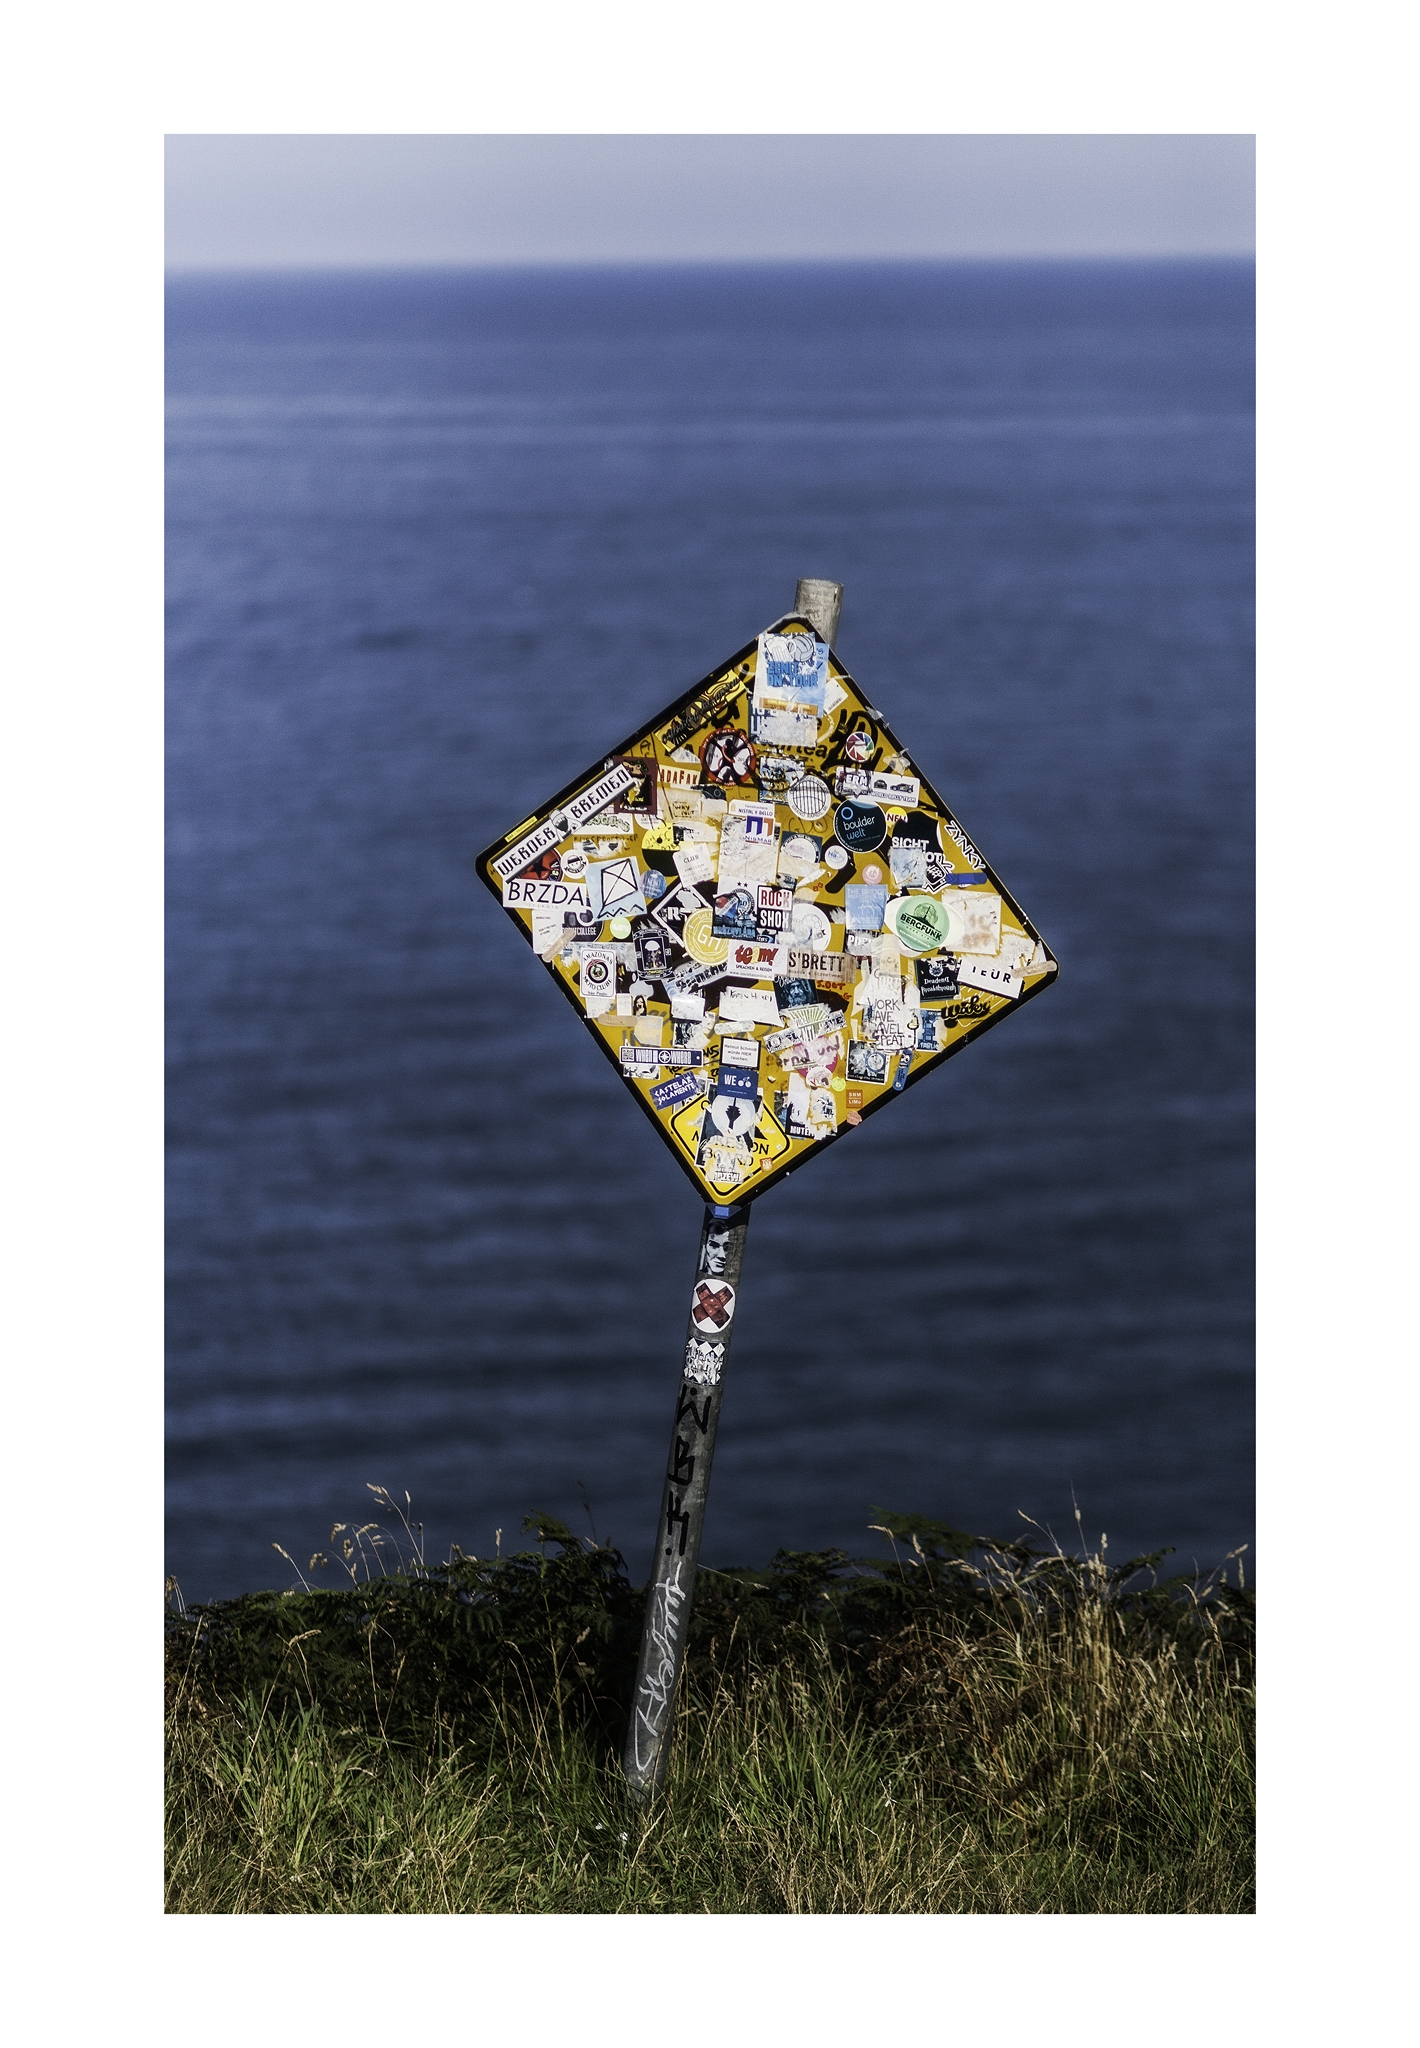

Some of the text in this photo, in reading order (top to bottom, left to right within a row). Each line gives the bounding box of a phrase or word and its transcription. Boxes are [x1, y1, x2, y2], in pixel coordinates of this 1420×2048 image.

[766, 661, 799, 674] ZENIT
[767, 674, 819, 687] ON TOUR
[570, 769, 630, 819] BREMEN
[843, 816, 875, 831] boulder
[846, 828, 866, 841] welt
[891, 836, 929, 850] SICHT
[497, 826, 556, 876] WERDER
[945, 820, 985, 869] ZYNKY
[507, 881, 585, 907] BRZDA
[760, 889, 790, 908] ROCK
[900, 913, 943, 941] BERGFUNK
[583, 950, 613, 966] AMAZONAS
[724, 1073, 737, 1086] WE
[658, 1083, 697, 1106] SOLAMENTE
